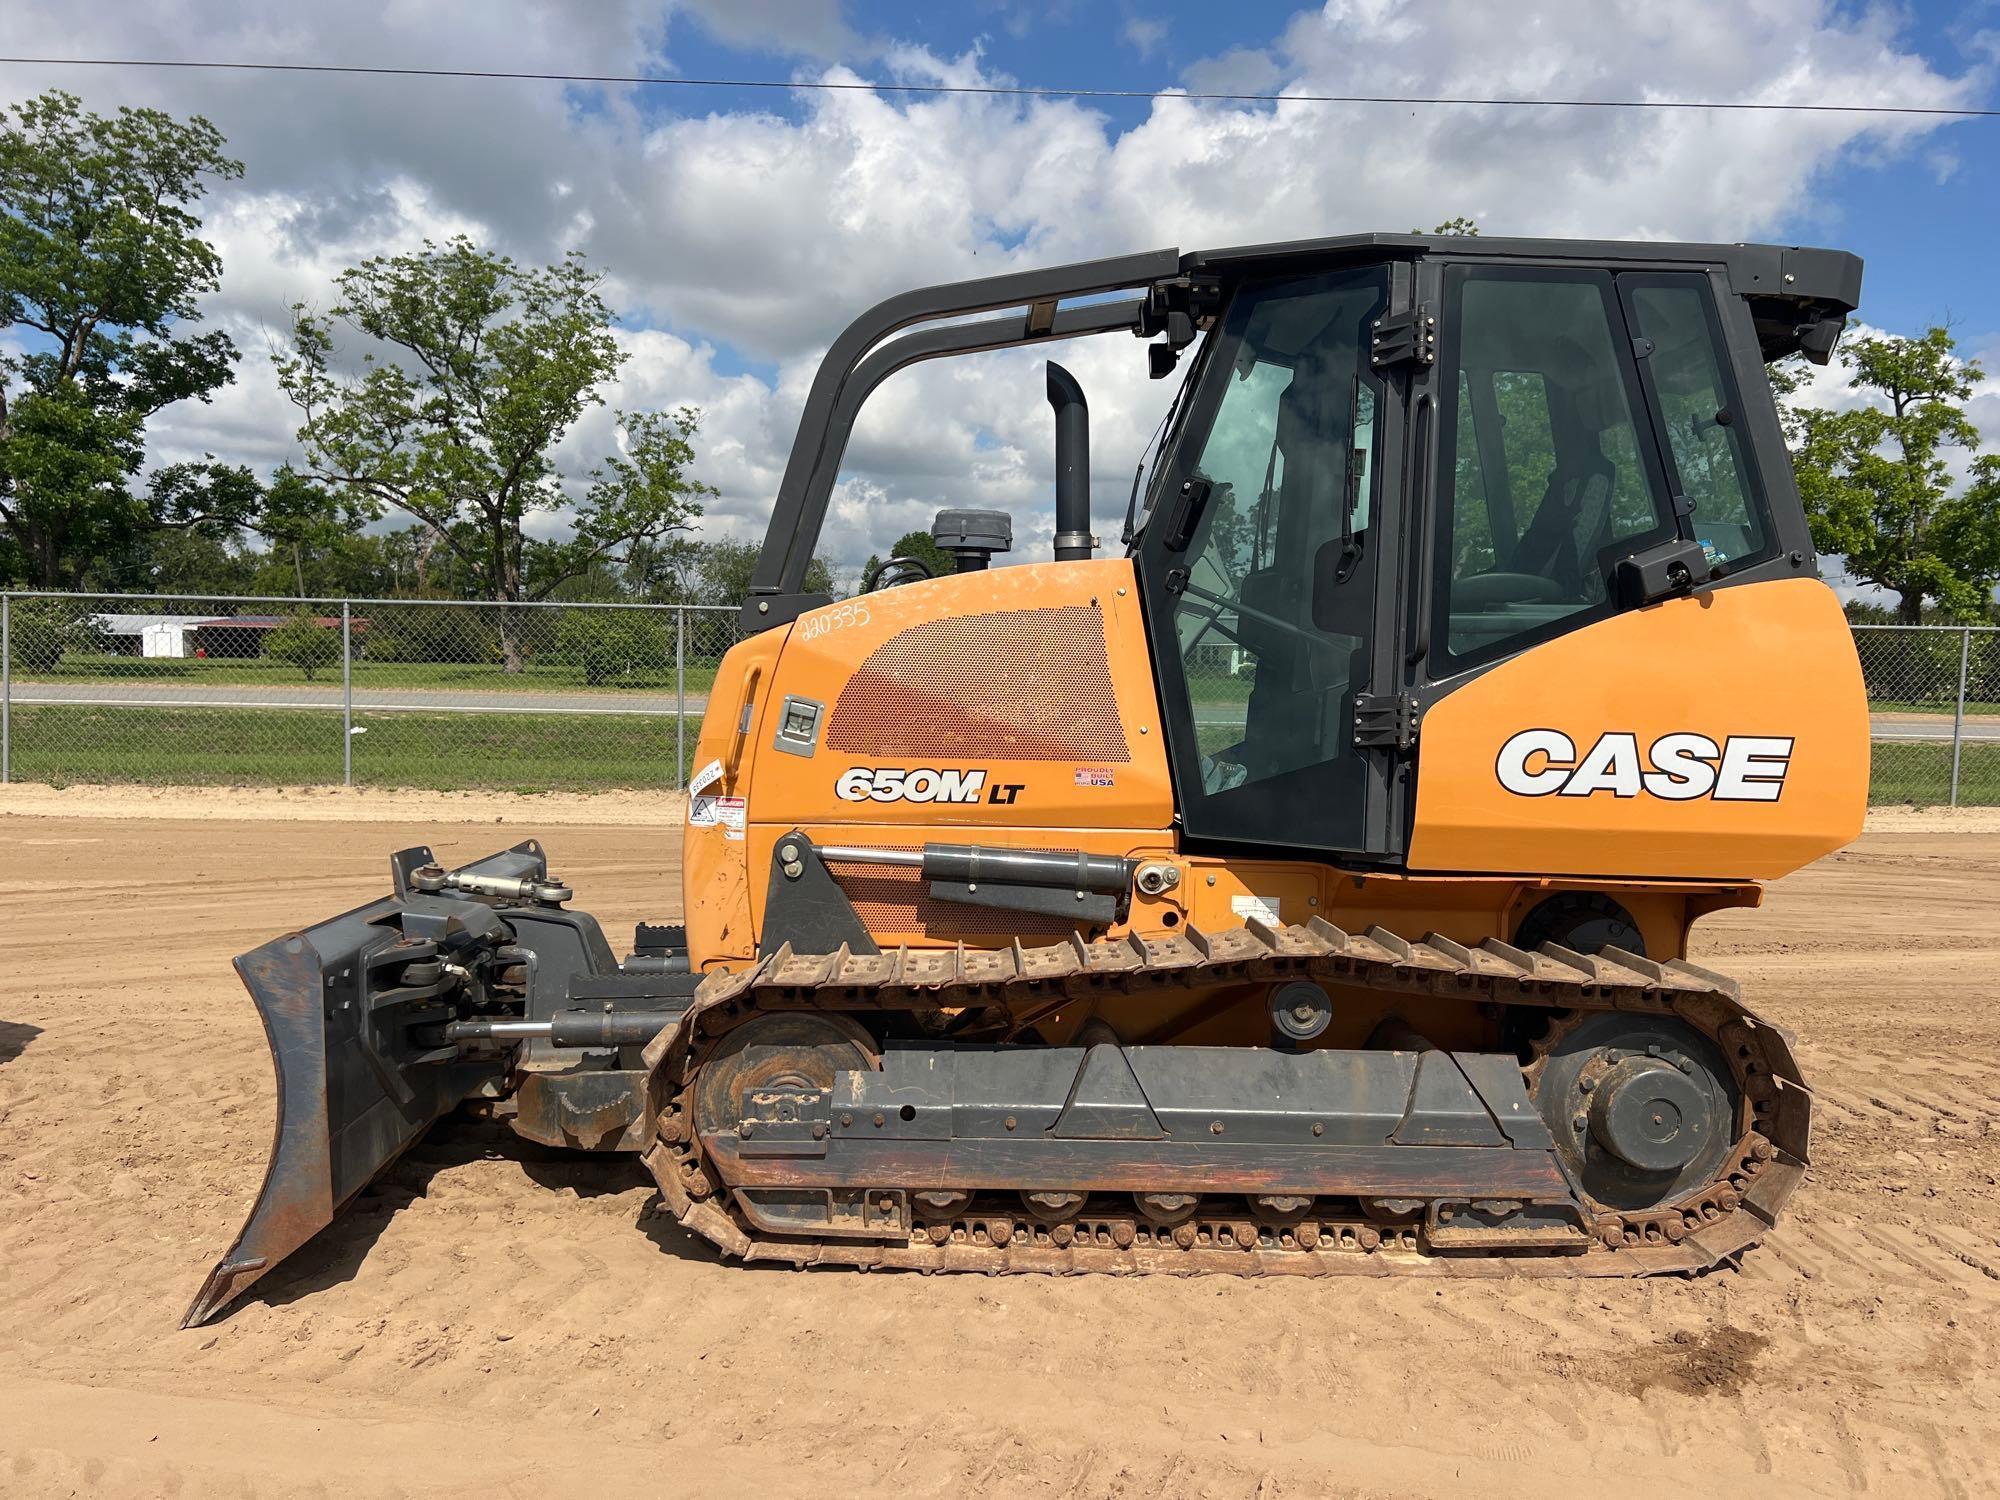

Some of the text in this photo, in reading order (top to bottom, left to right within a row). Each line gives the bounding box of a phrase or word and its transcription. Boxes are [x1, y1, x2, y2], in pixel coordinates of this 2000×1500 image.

[800, 601, 871, 642] 220335
[834, 767, 1025, 804] 650M LT
[1495, 728, 1795, 802] CASE
